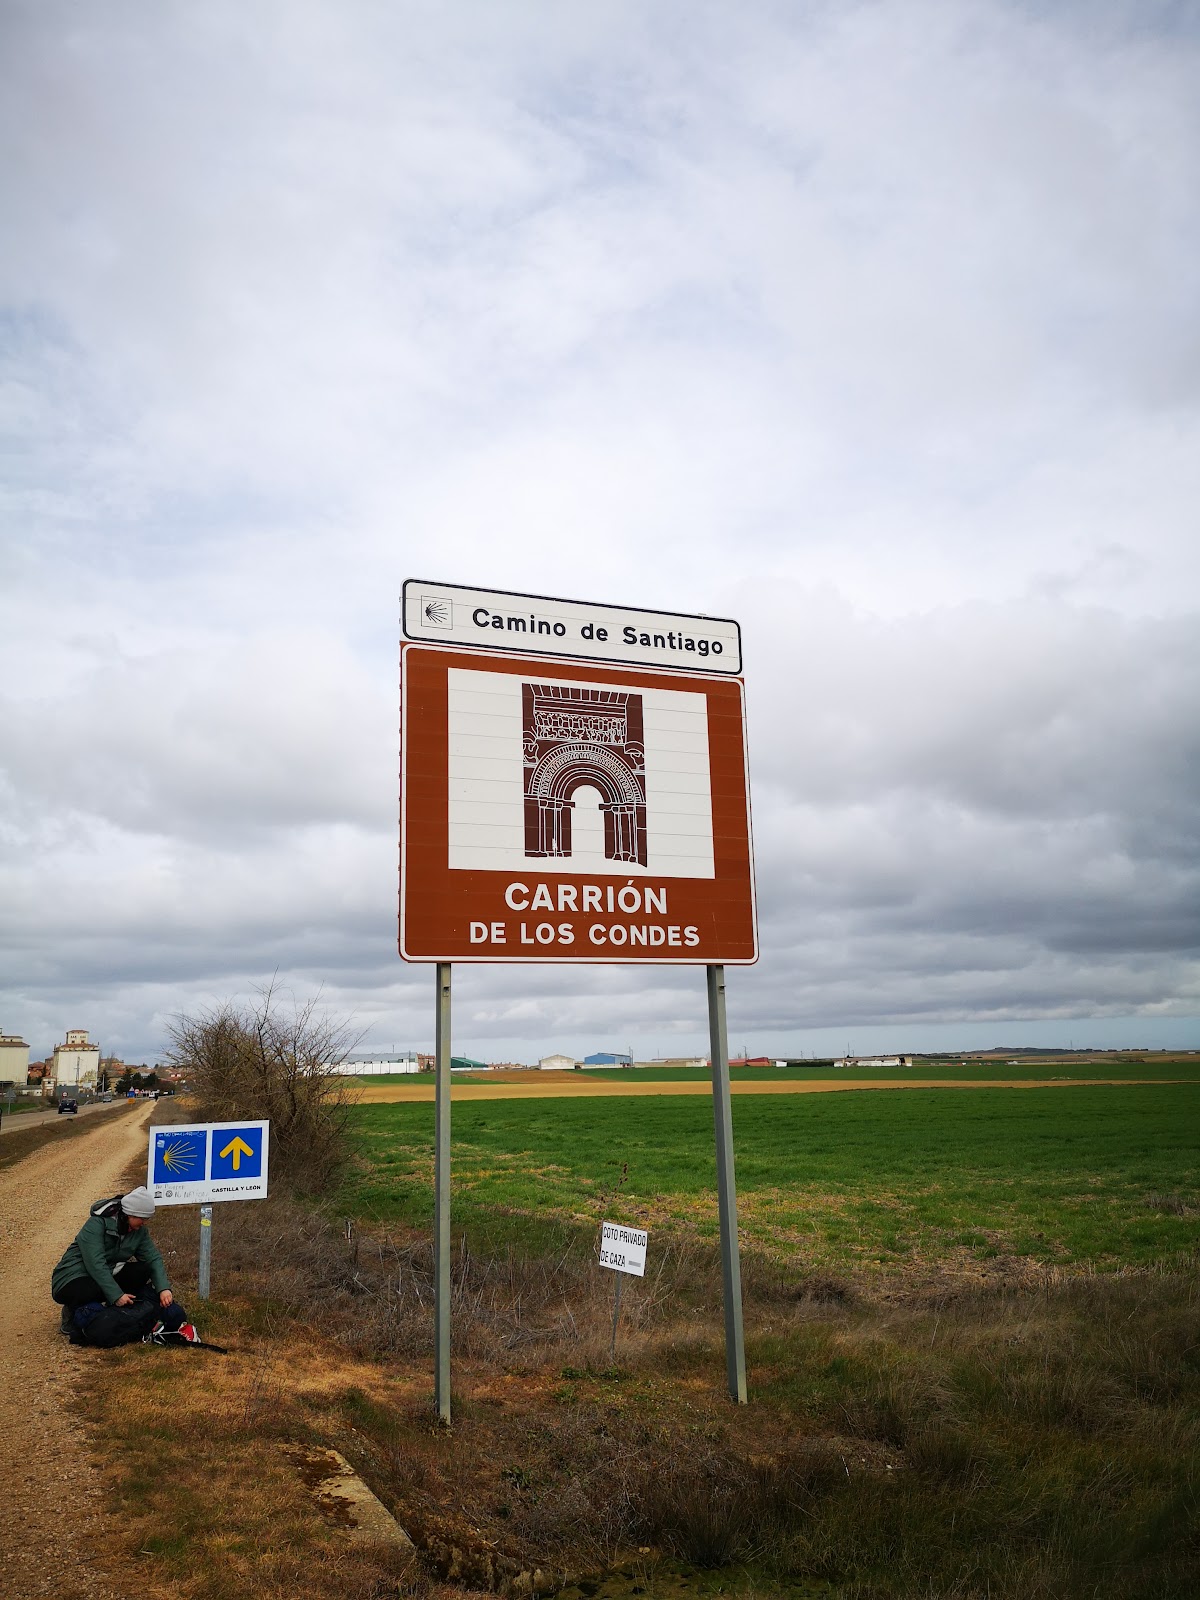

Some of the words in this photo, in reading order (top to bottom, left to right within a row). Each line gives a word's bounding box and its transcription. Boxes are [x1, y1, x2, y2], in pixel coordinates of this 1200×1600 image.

[472, 608, 567, 637] Camino
[580, 624, 609, 642] de
[622, 626, 724, 657] Santiago
[504, 880, 668, 915] CARRIÓN
[469, 921, 507, 944] DE
[520, 922, 575, 945] LOS
[588, 923, 701, 947] CONDES
[603, 1226, 619, 1241] COTO
[619, 1230, 647, 1247] PRIVADO
[600, 1250, 609, 1263] DE
[609, 1252, 626, 1268] CAZA
